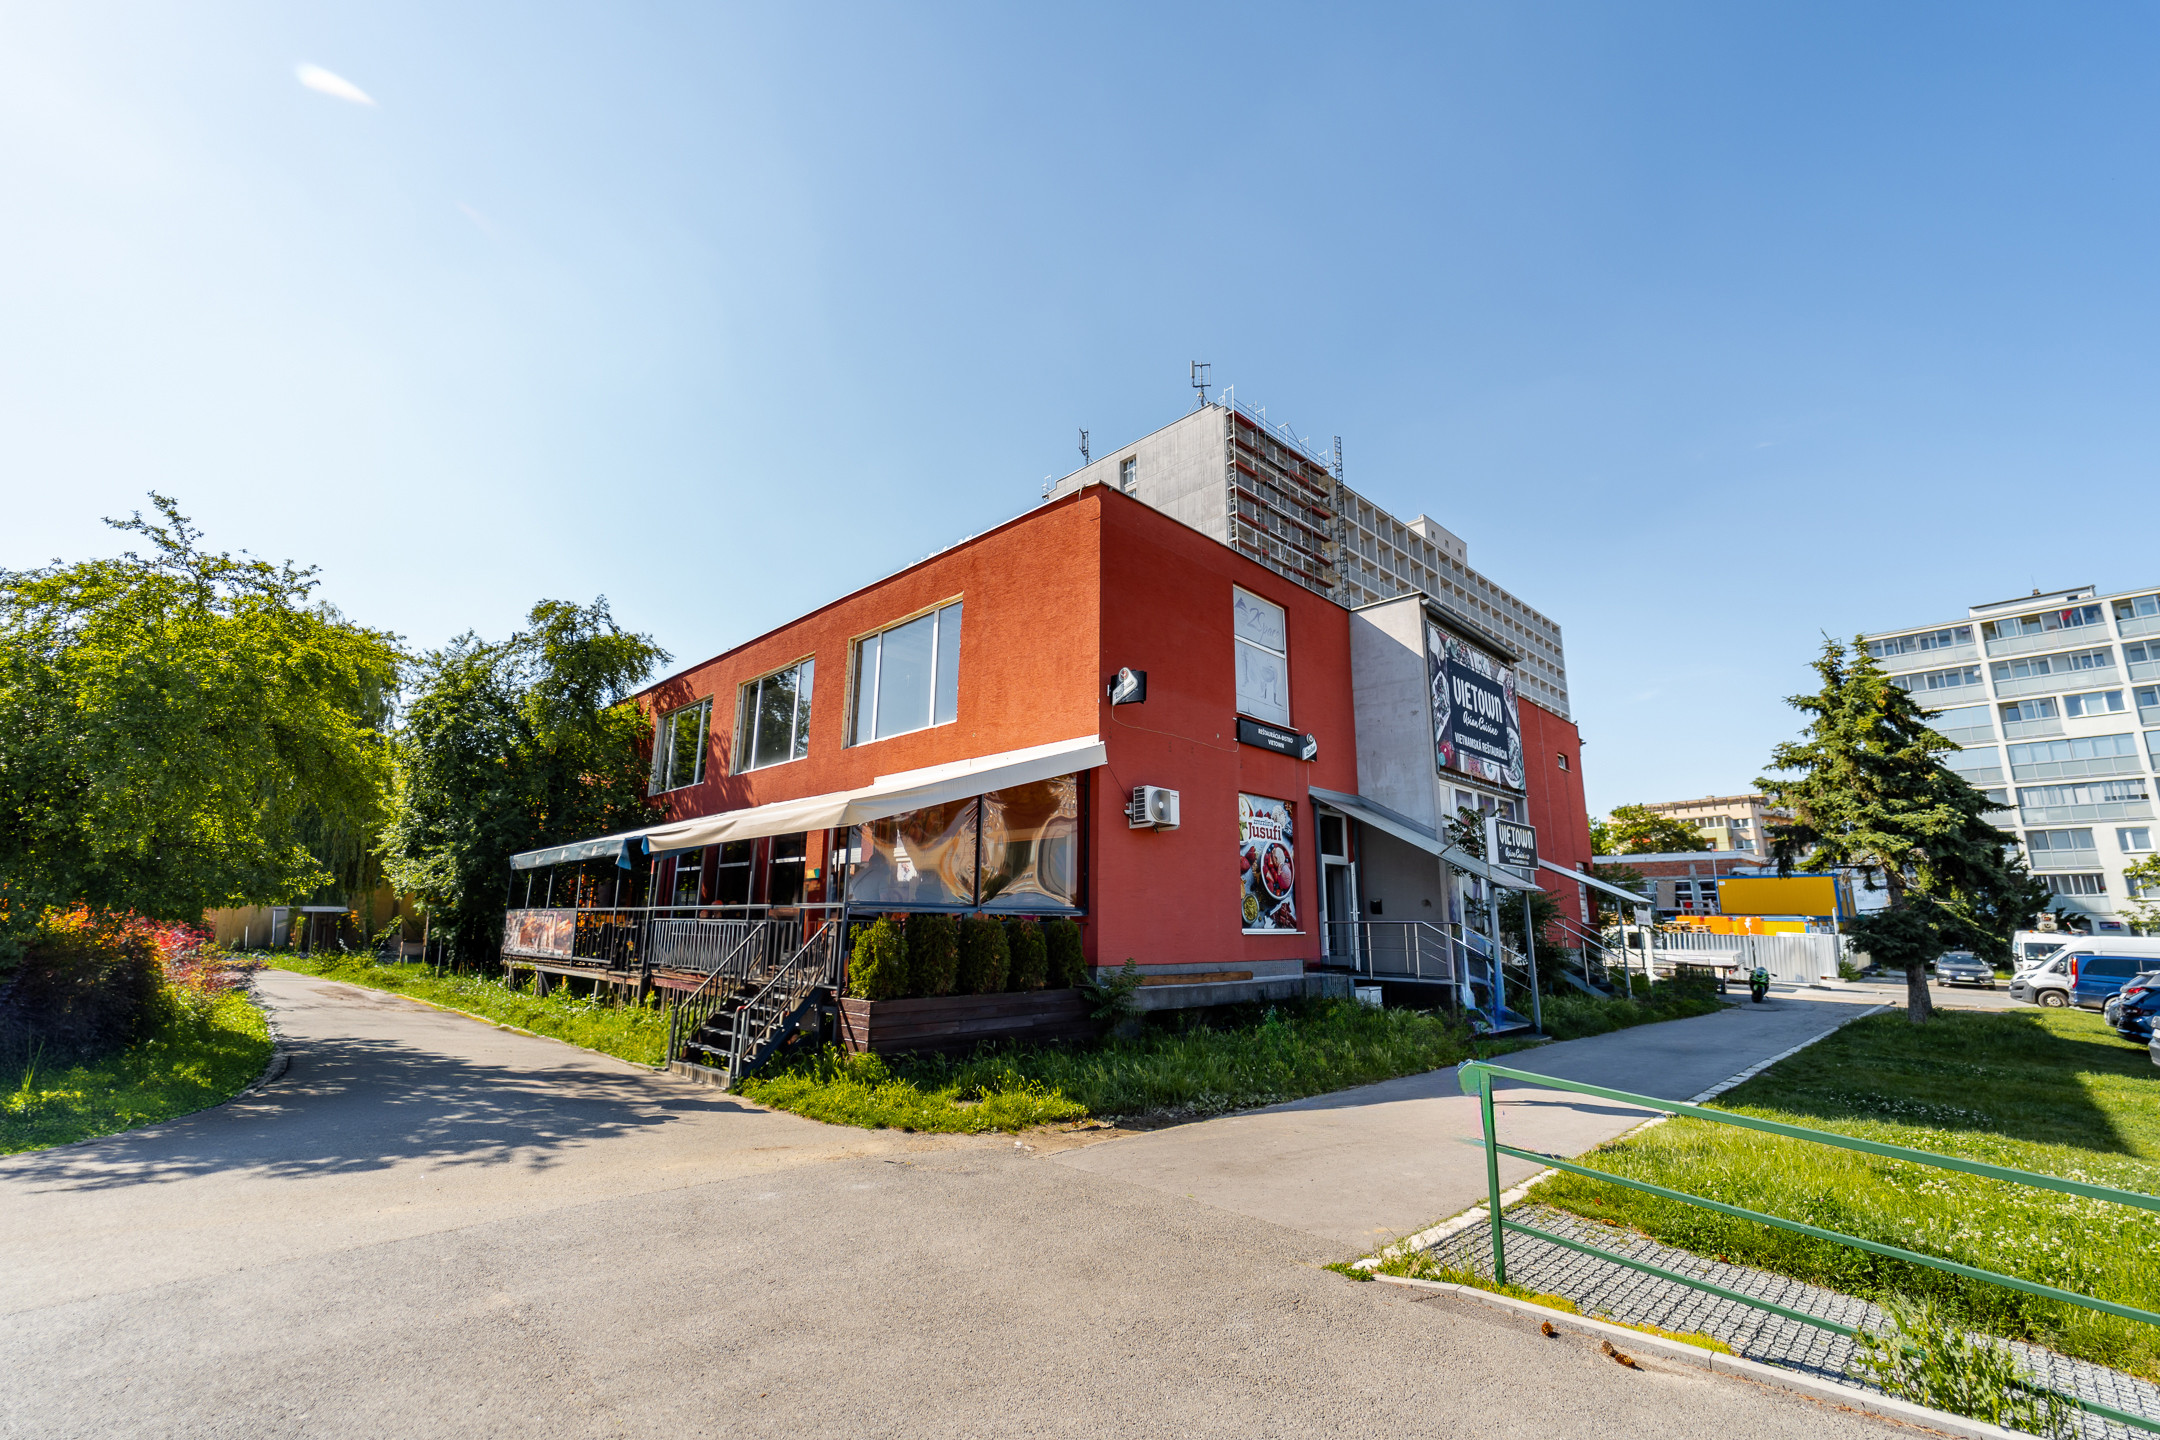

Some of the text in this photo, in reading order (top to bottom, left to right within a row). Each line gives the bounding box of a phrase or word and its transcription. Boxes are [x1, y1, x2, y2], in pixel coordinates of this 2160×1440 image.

[1453, 676, 1503, 723] VIETOWN
[1248, 822, 1281, 840] Jusufi
[1499, 824, 1534, 849] VIETOWN
